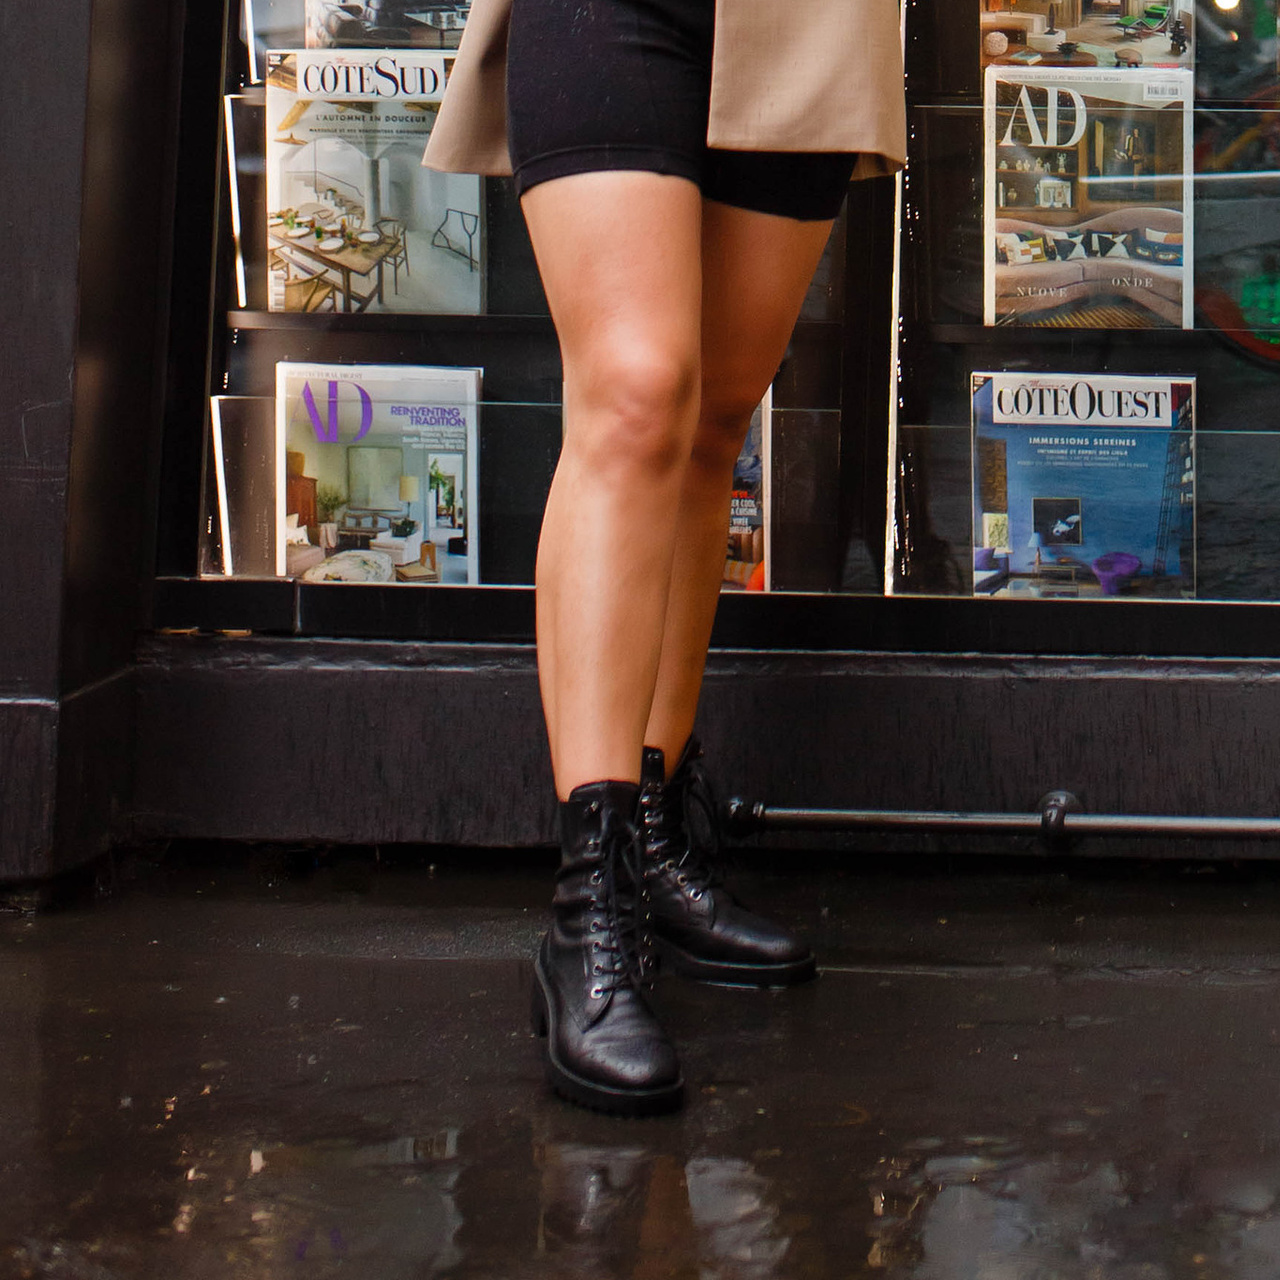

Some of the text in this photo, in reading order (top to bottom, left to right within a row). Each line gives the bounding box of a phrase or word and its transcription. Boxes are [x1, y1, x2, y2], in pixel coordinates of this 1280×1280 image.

[316, 114, 366, 122] L'AUTOMNE
[385, 115, 426, 123] DOUCEUR
[998, 84, 1087, 147] AD
[1111, 276, 1153, 288] ONDE
[1016, 286, 1068, 298] NUOVE
[287, 379, 373, 443] AD
[390, 406, 460, 417] REINVENTING
[410, 416, 466, 427] TRADITION
[1029, 437, 1137, 447] IMMERSIONS SEREINES
